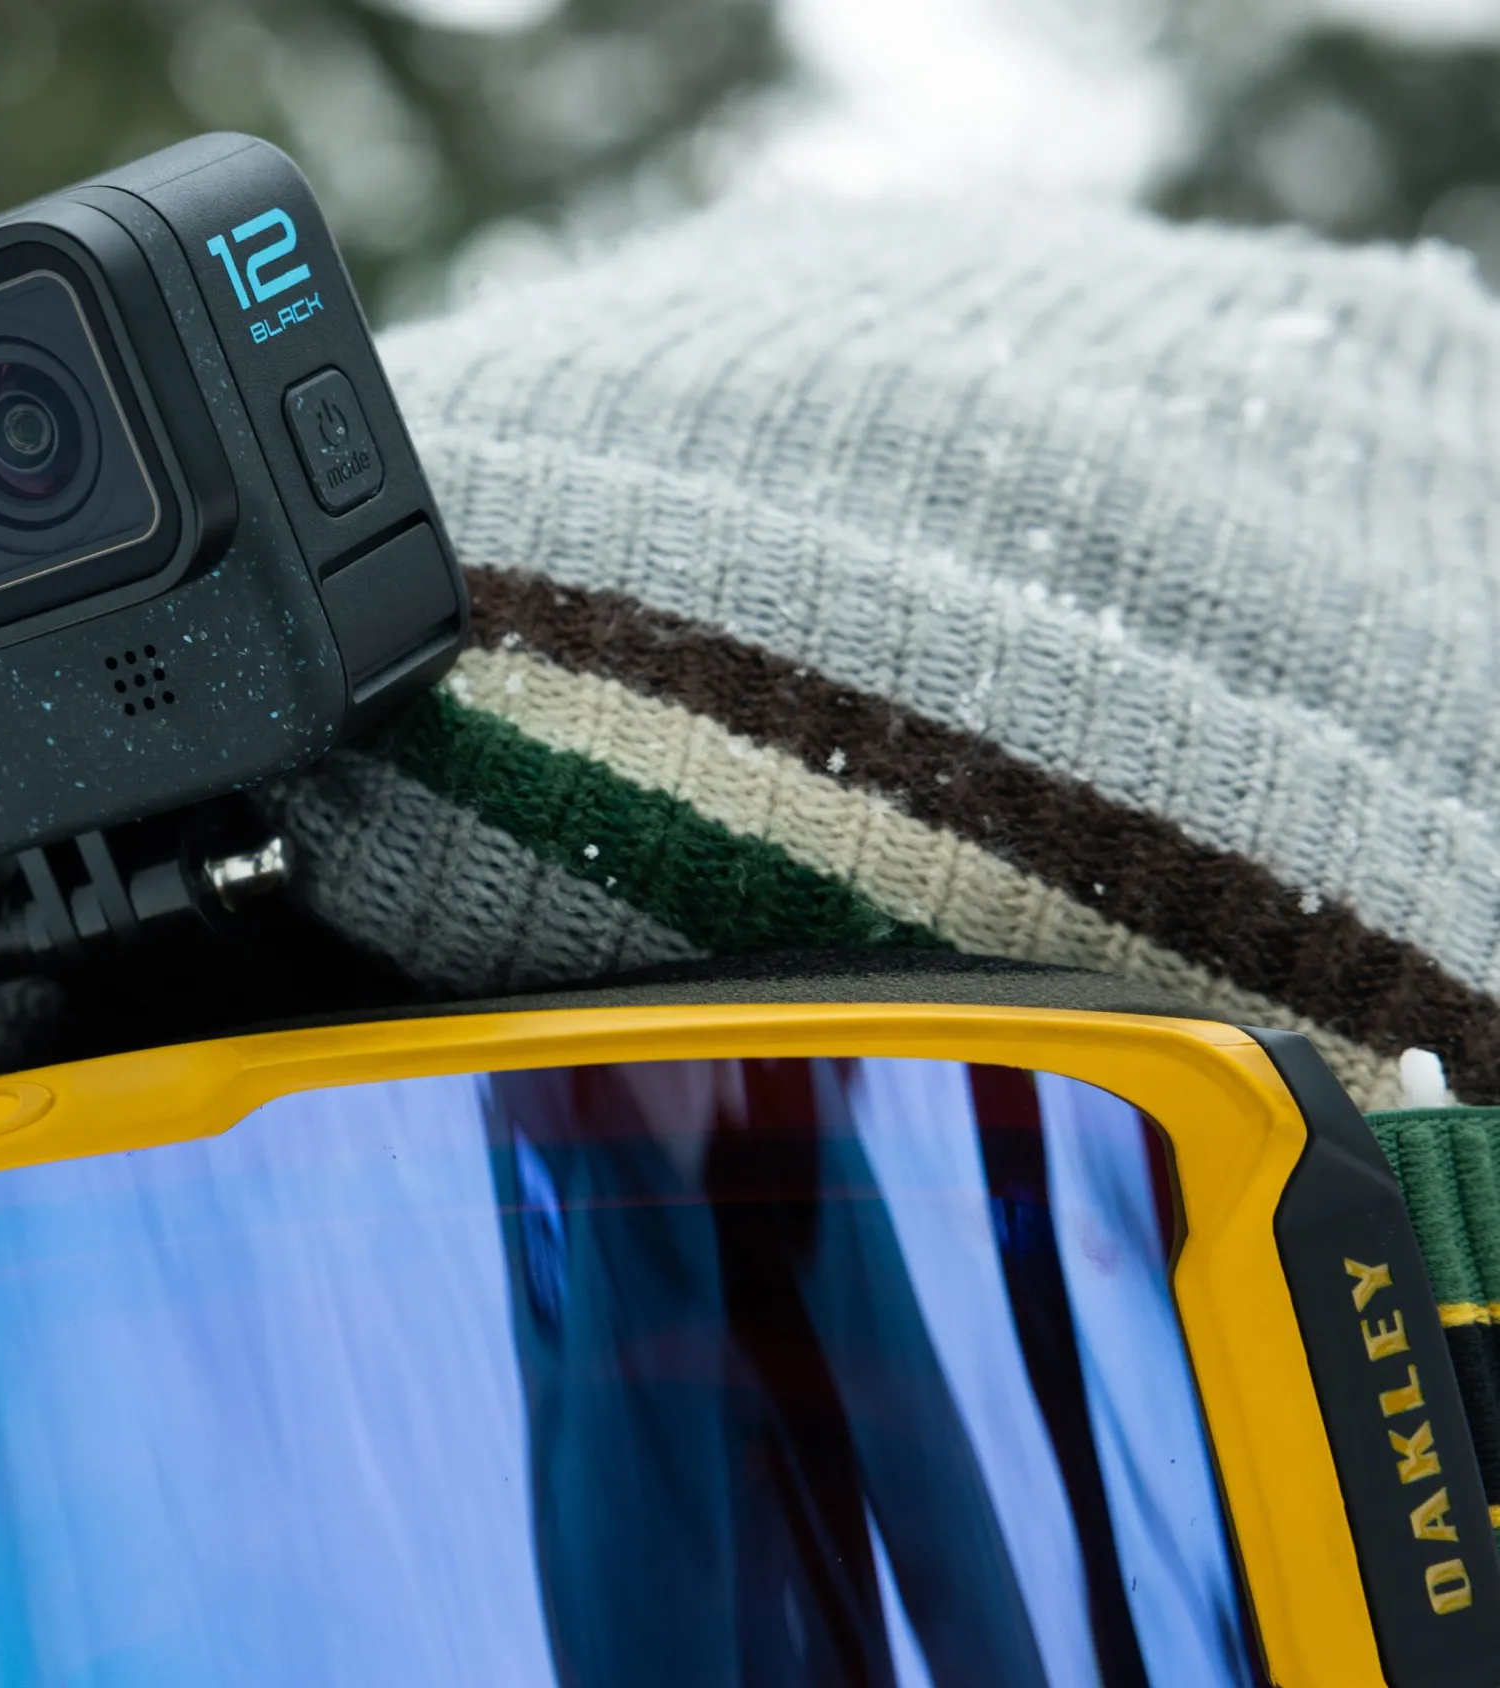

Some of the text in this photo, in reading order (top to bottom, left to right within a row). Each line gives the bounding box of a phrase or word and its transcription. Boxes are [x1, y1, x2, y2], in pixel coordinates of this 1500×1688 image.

[207, 208, 311, 310] 12
[250, 292, 324, 344] BLACK
[326, 451, 371, 489] mode
[1343, 1256, 1473, 1616] OAKLEY
